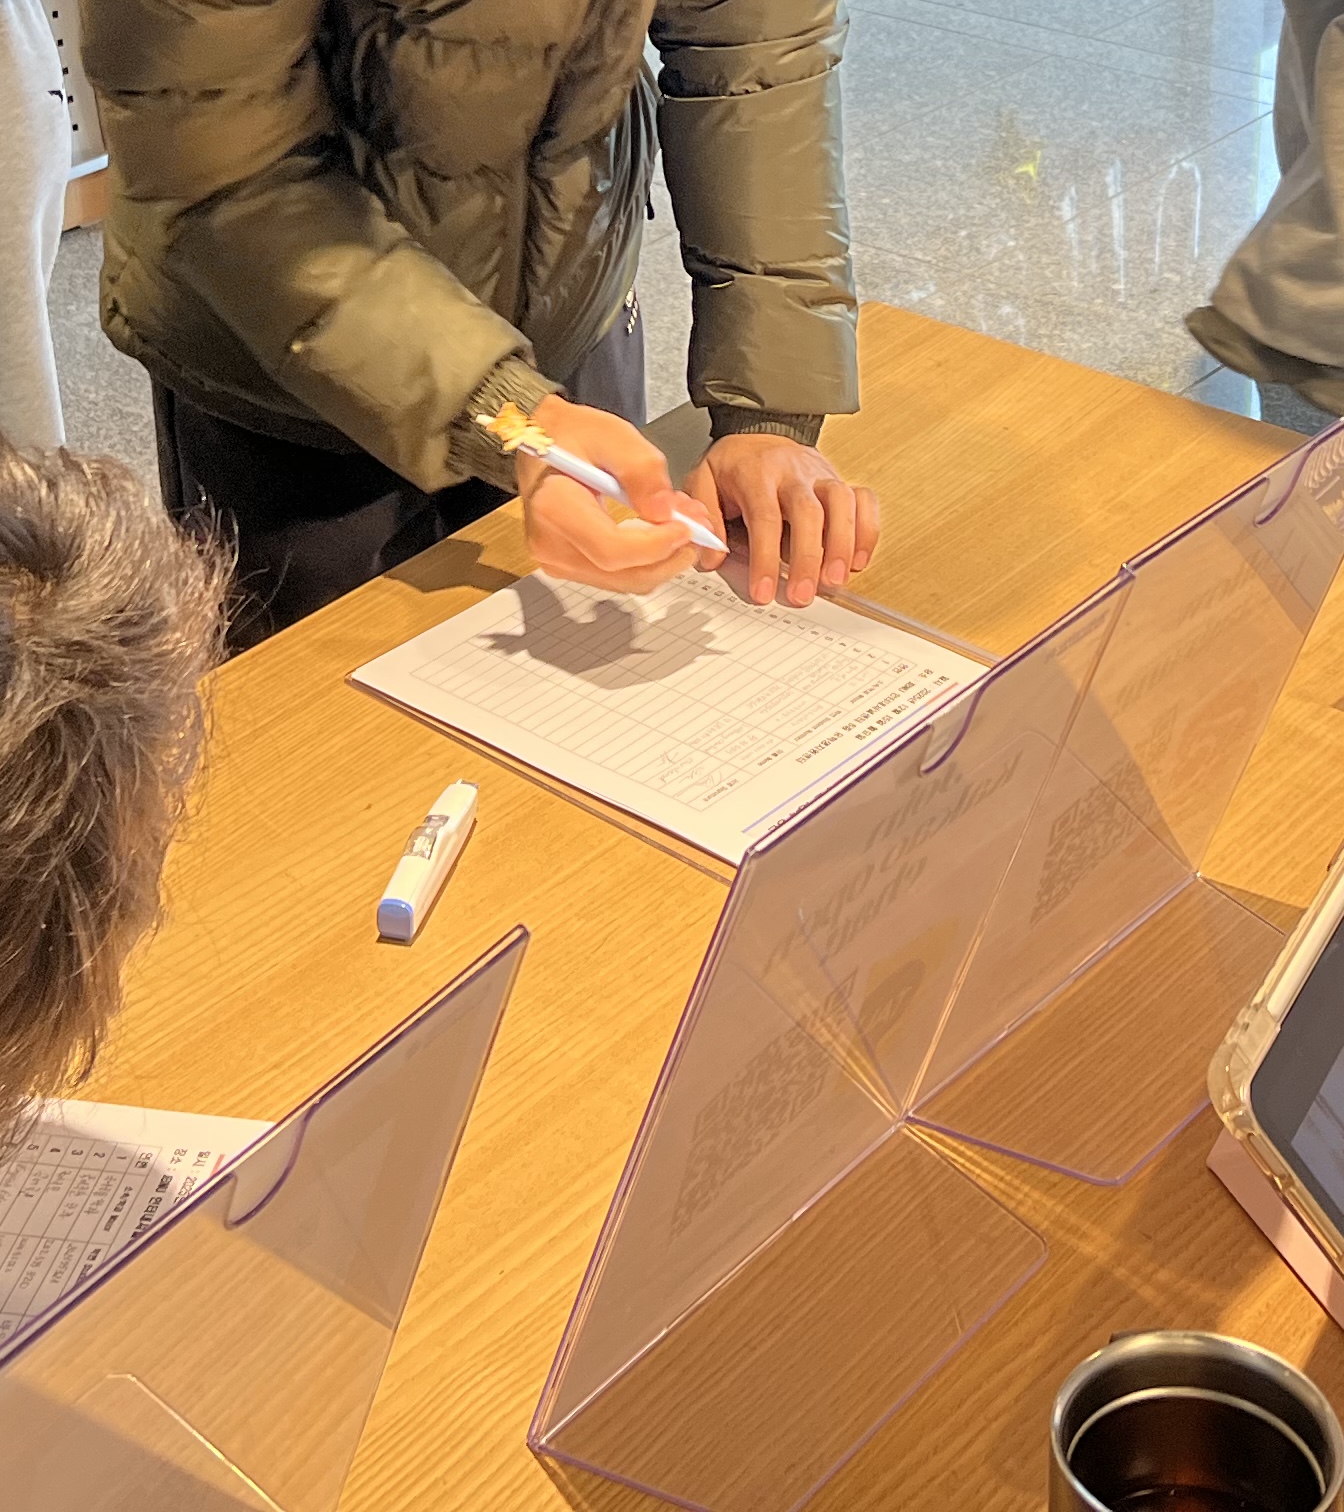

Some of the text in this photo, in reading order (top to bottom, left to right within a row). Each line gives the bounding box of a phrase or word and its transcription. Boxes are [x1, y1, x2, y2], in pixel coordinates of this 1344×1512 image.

[69, 1148, 84, 1156] 3
[132, 1151, 154, 1169] 연번
[167, 1147, 188, 1165] 장소
[190, 1150, 212, 1168] 일시
